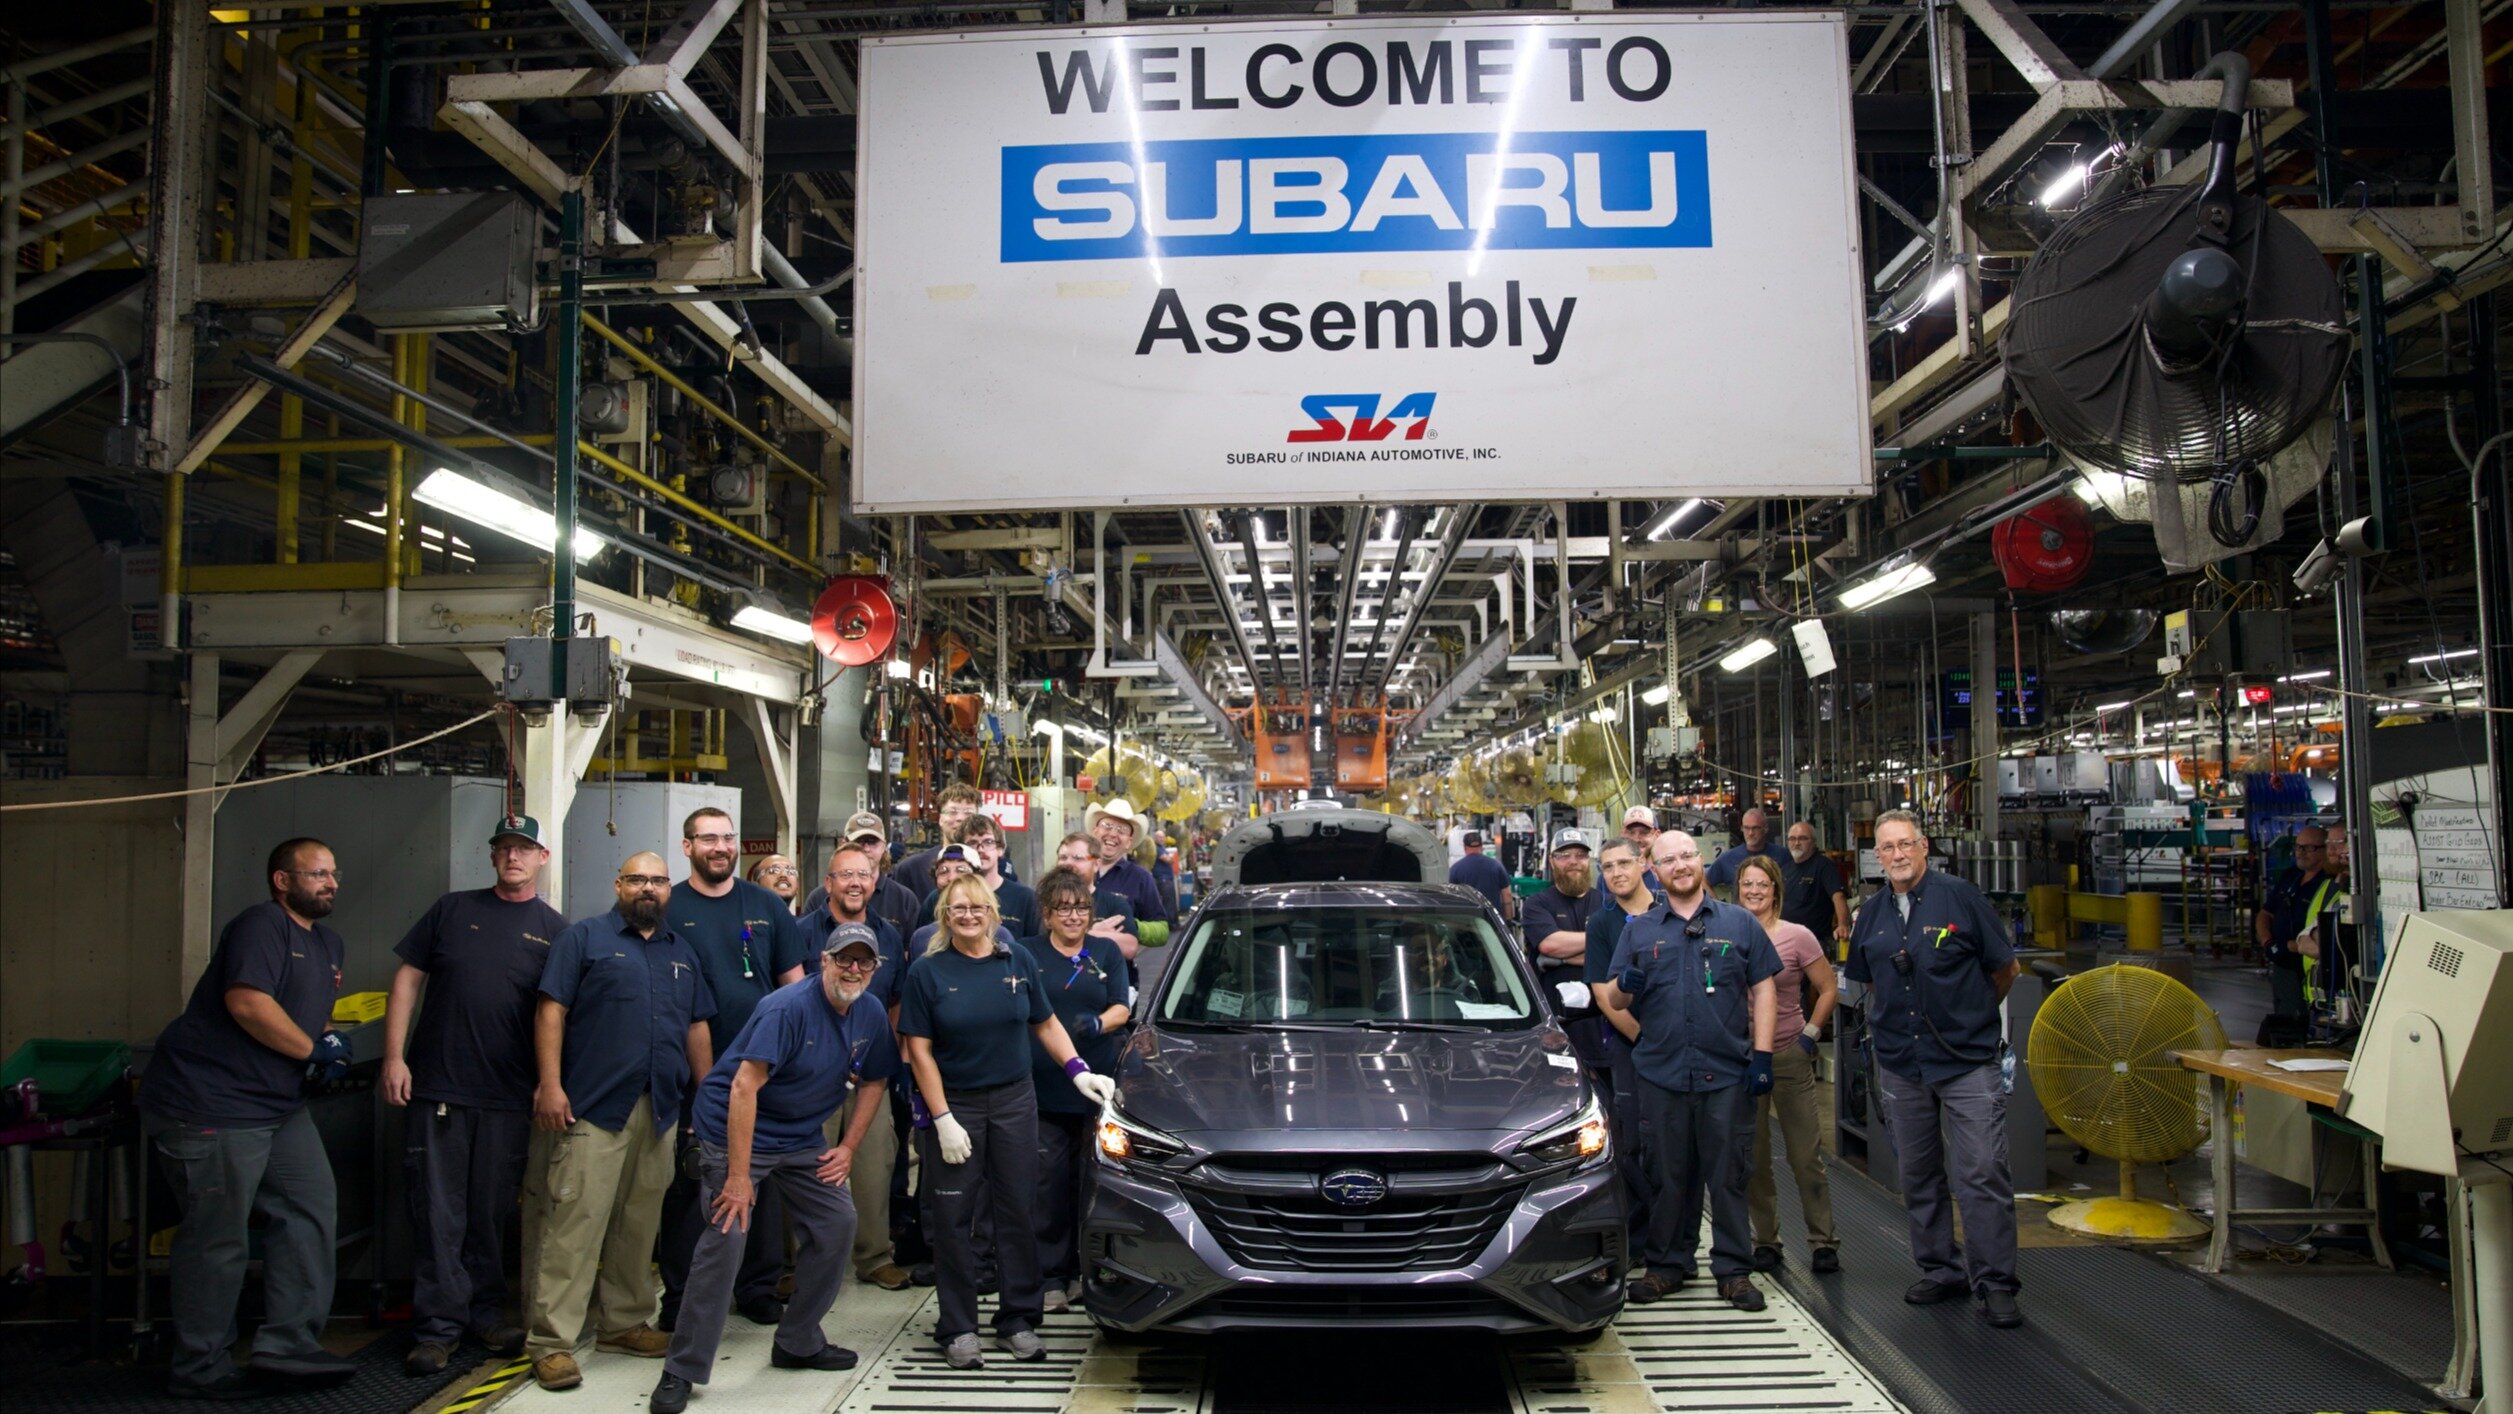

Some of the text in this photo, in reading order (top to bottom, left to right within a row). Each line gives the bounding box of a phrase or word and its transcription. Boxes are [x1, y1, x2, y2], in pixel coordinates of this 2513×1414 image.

[1036, 36, 1672, 115] WELCOME TO
[1033, 151, 1678, 241] SUBARU
[1135, 280, 1577, 365] Assembly
[1226, 447, 1502, 464] SUBARU of INDIANA AUTOMOTIVE, INC.
[983, 792, 1025, 806] PILL
[749, 841, 774, 853] DAN
